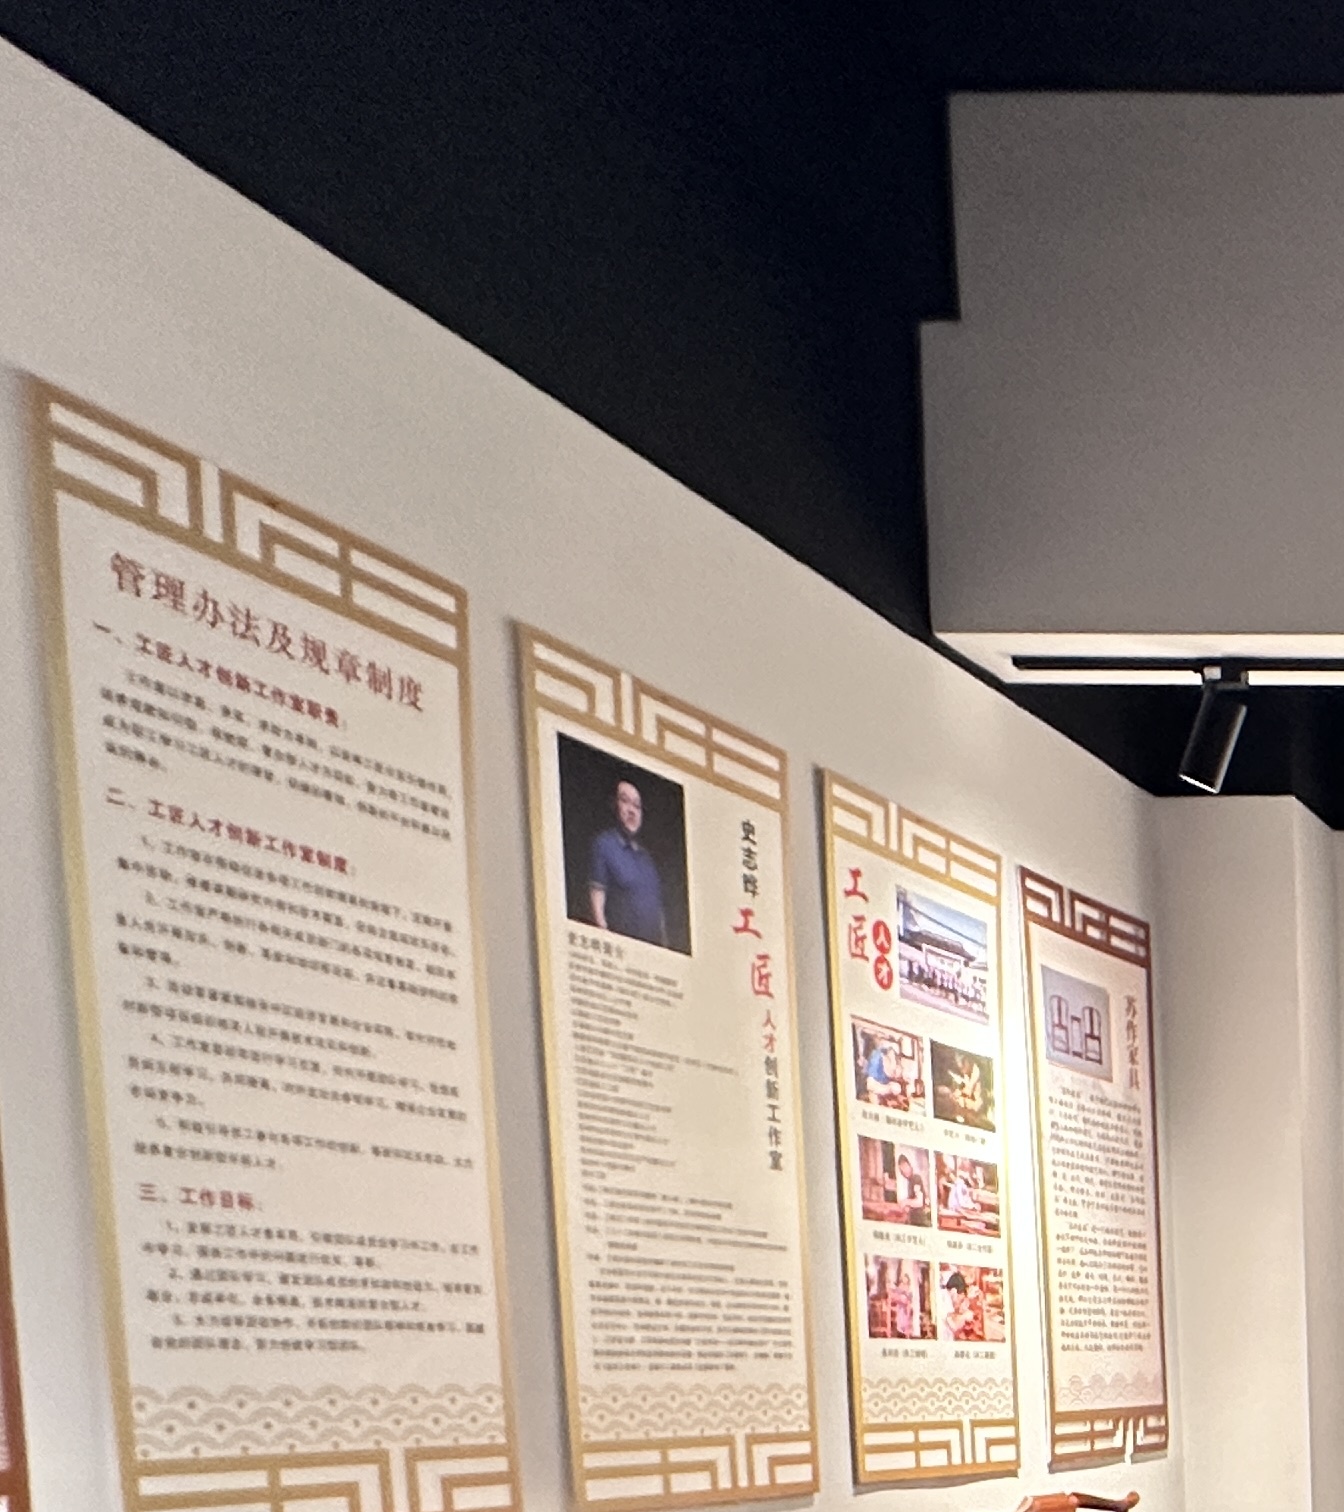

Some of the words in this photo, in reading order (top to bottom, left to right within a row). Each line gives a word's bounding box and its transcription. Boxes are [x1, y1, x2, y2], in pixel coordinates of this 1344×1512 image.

[110, 551, 423, 712] 管理办法及规章制度
[844, 868, 869, 963] 工匠
[873, 920, 893, 991] 人才
